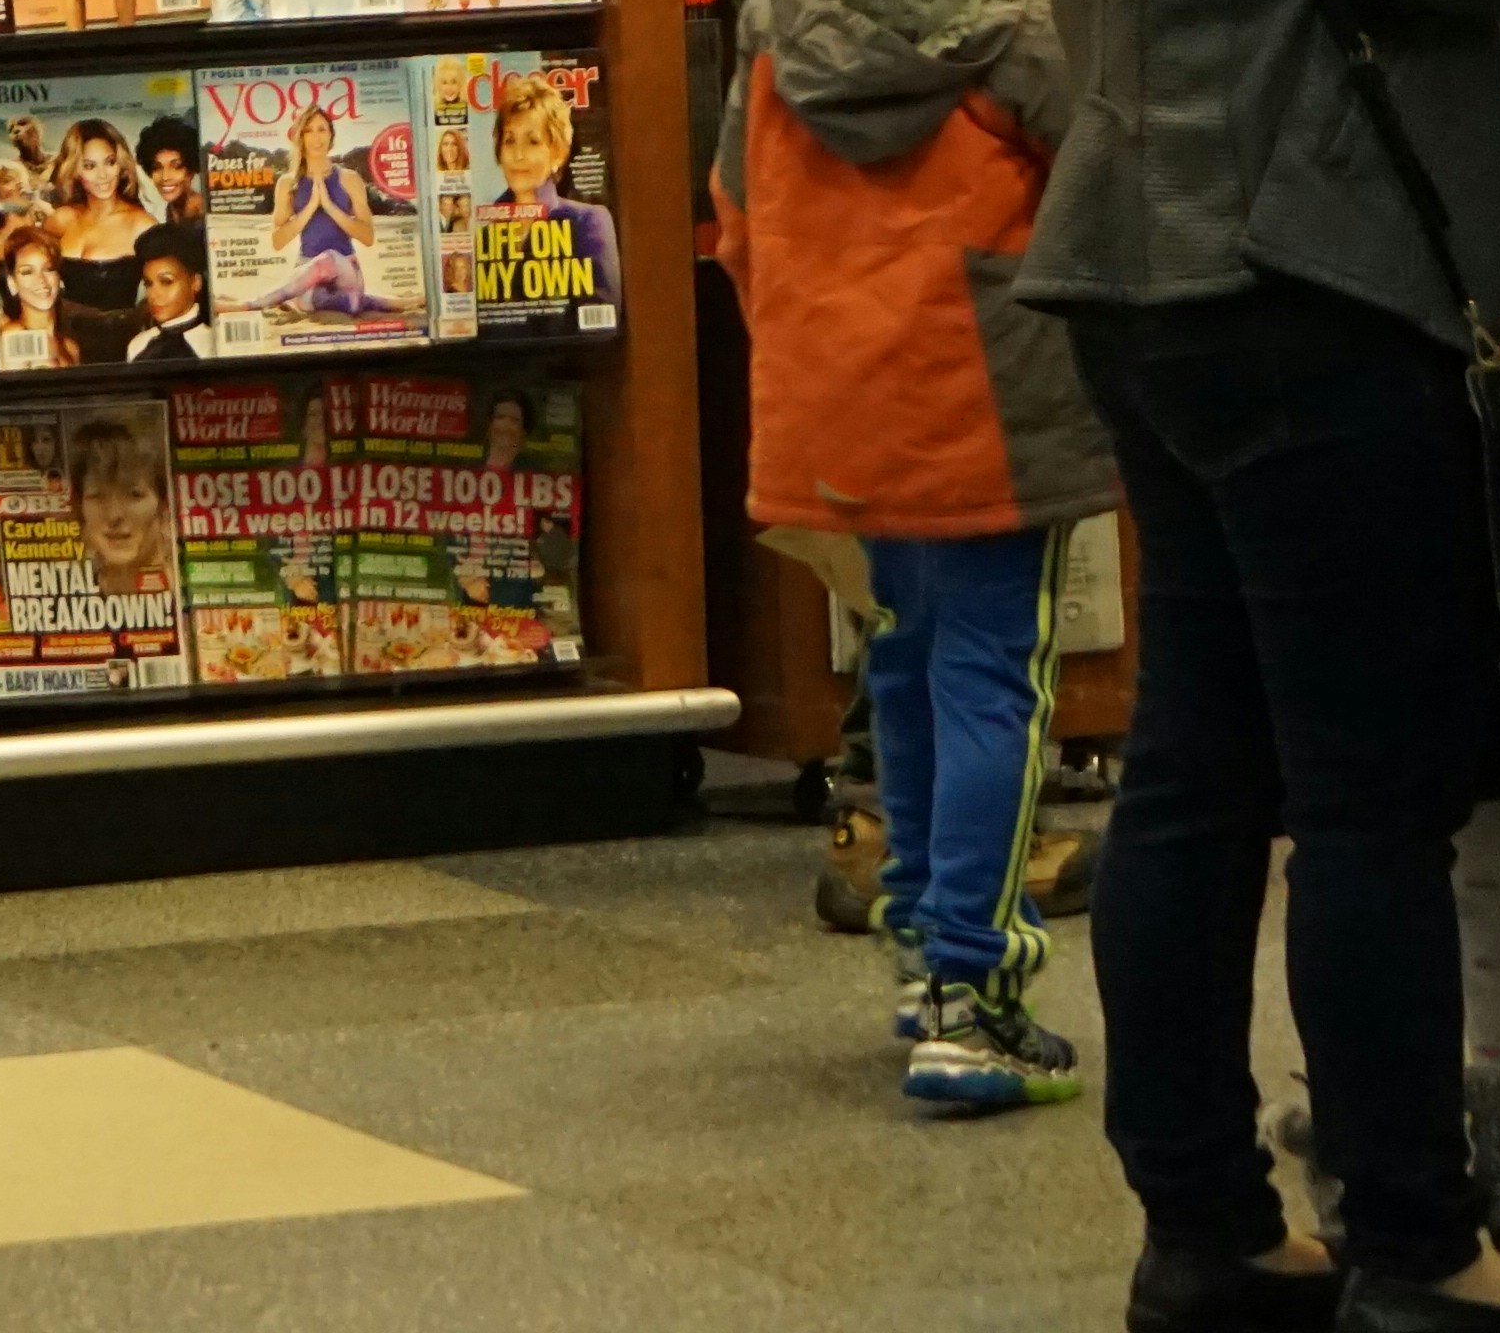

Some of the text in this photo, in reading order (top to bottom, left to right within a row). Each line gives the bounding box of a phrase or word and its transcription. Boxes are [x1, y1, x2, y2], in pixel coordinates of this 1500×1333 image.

[207, 169, 275, 188] POWER
[512, 203, 545, 220] JUDY
[476, 219, 573, 262] LIFE ON
[477, 257, 595, 301] MY OWN
[177, 470, 323, 508] LOSE 100
[360, 464, 573, 510] LOSE 100 LBS
[2, 519, 81, 539] Caroline
[359, 497, 526, 535] in 12 weeks!
[6, 559, 100, 596] MENTAL
[10, 591, 175, 633] BREAKDOWN!
